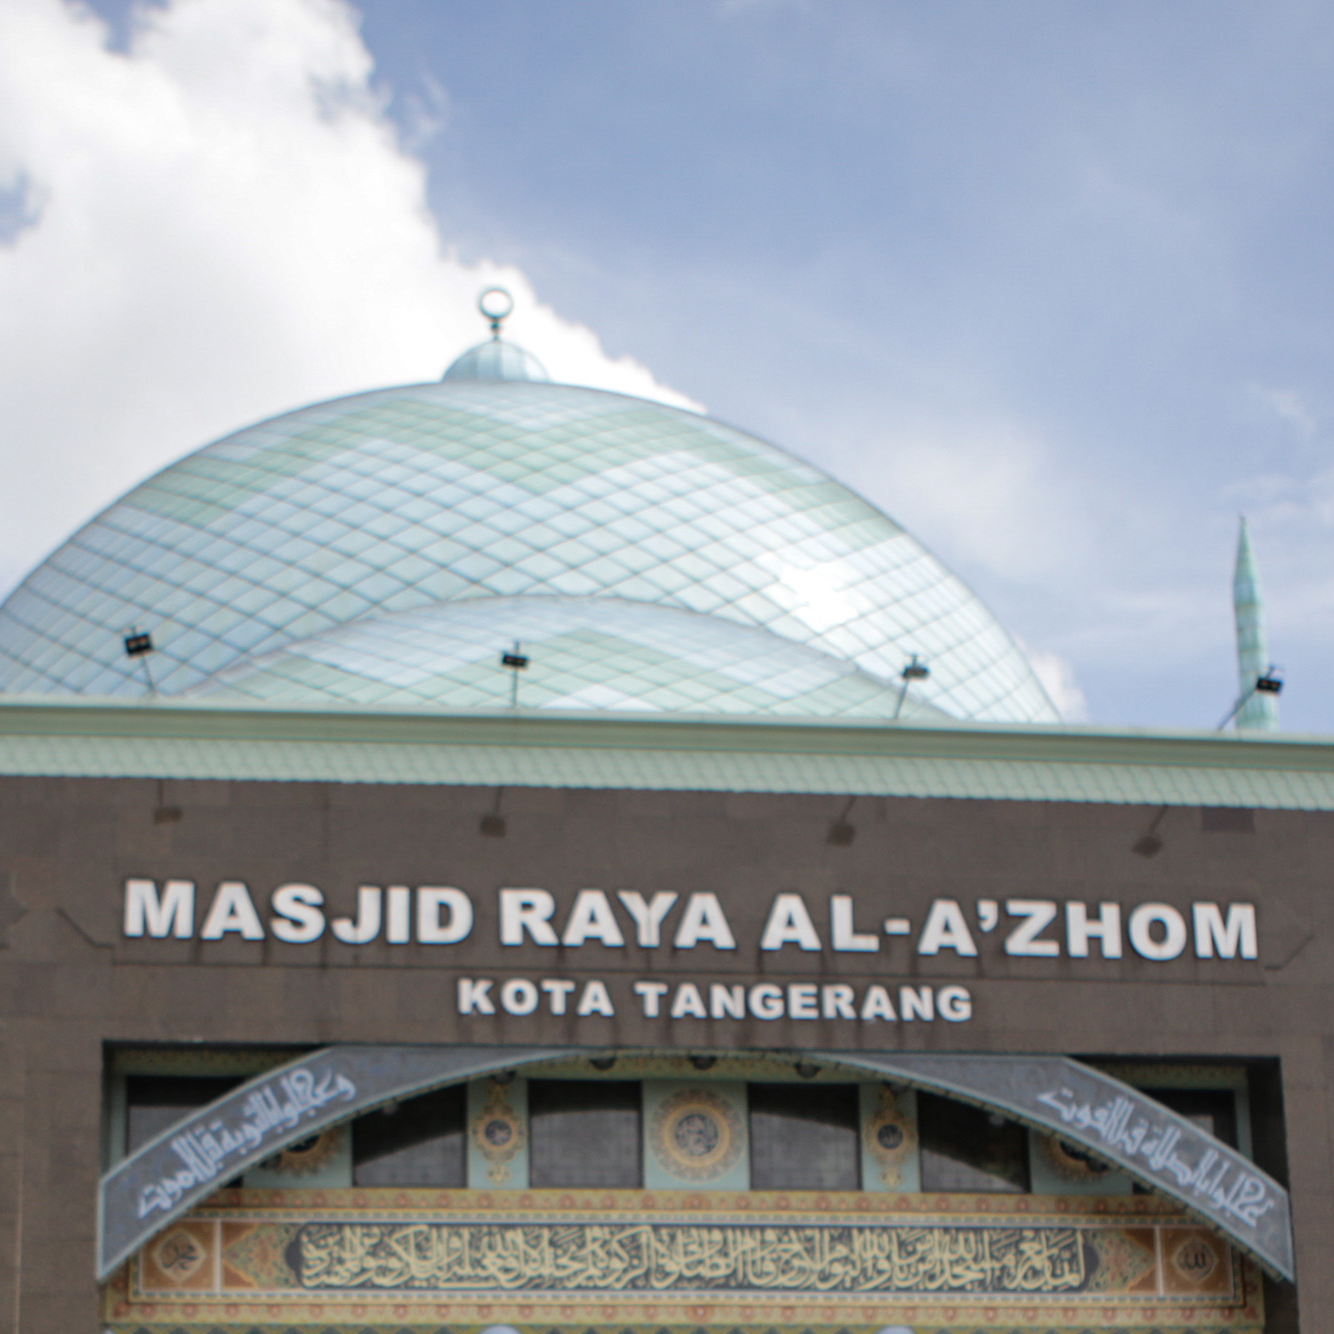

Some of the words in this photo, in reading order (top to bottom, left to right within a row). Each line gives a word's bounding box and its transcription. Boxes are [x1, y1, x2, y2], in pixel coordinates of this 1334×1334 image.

[124, 879, 474, 943] MASJID
[499, 888, 737, 949] RAYA
[458, 978, 614, 1016] KOTA
[634, 982, 973, 1022] TANGERANG
